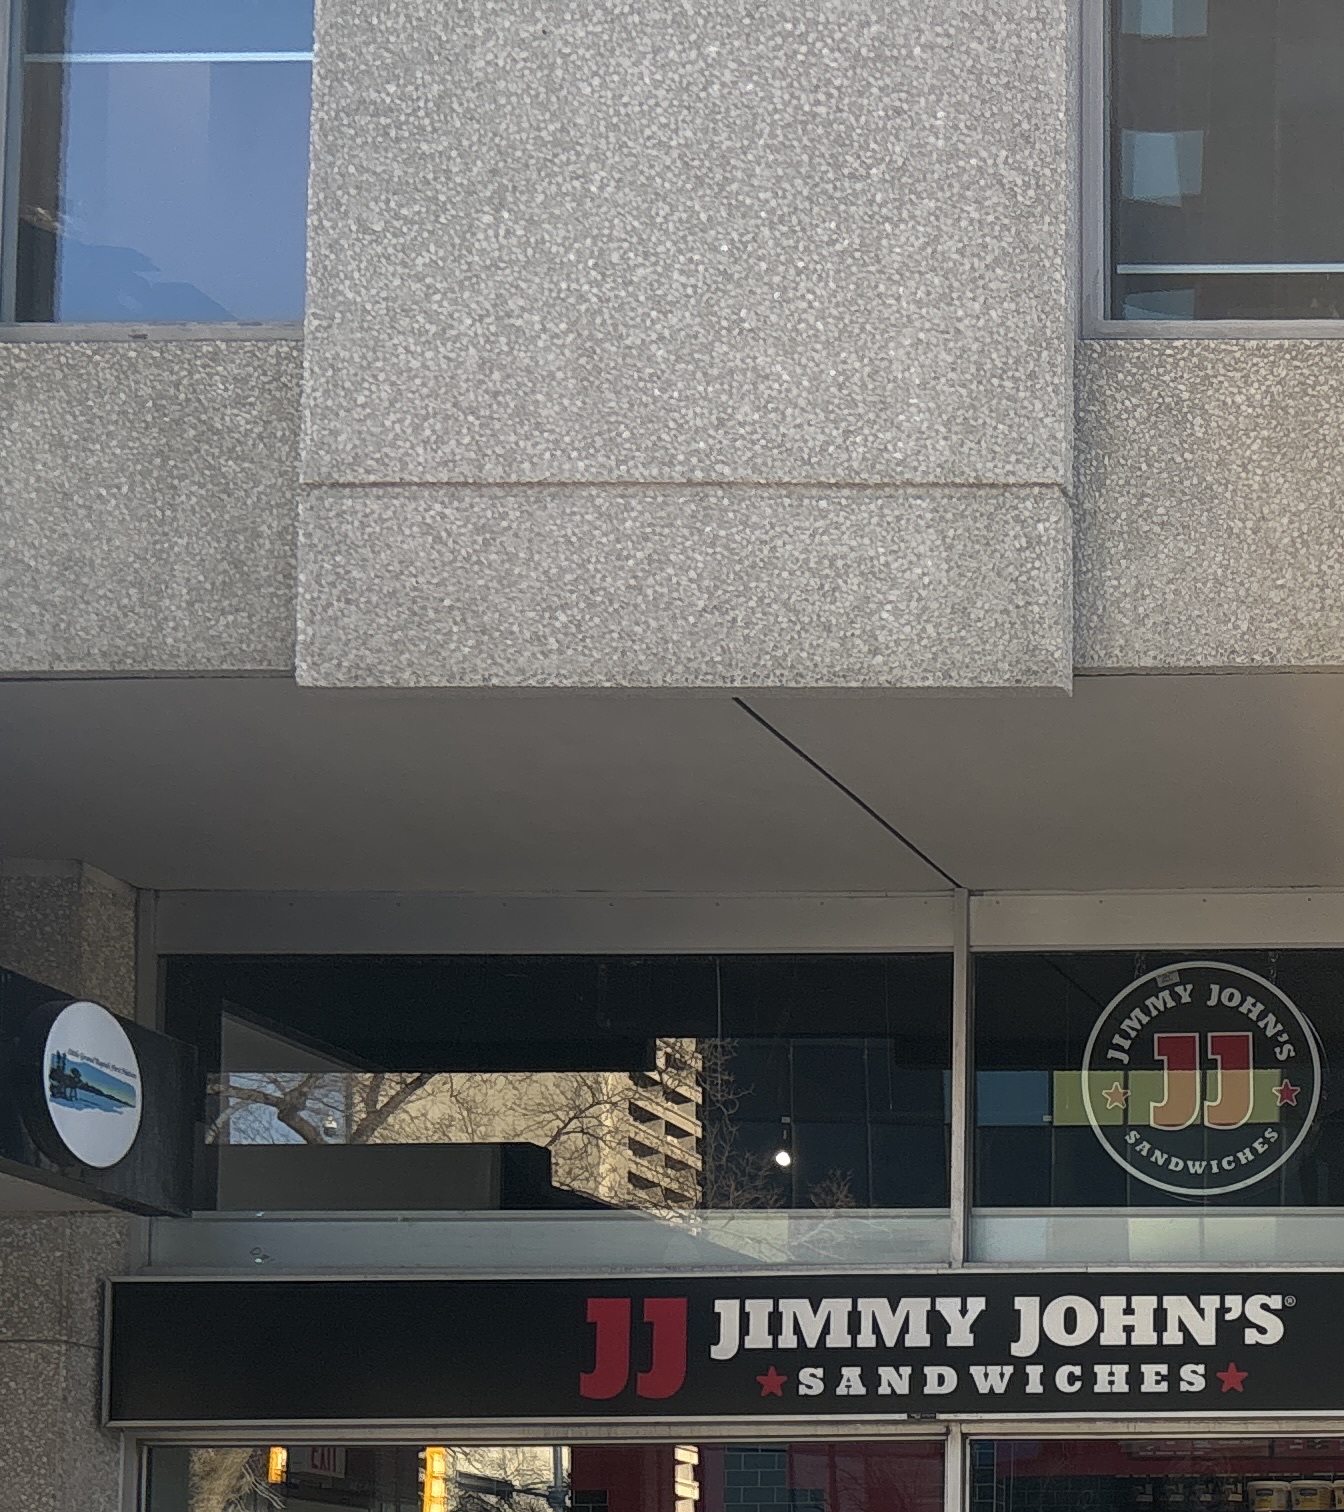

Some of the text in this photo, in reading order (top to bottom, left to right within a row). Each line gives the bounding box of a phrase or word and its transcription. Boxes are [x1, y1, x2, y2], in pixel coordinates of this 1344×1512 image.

[1107, 983, 1296, 1065] JIMMY JOHN'S
[1150, 1031, 1254, 1132] JJ
[1124, 1127, 1280, 1175] SANDWICHES
[580, 1297, 688, 1399] JJ
[710, 1294, 1286, 1360] JIMMY JOHN'S
[797, 1362, 1207, 1397] SANDWICHES
